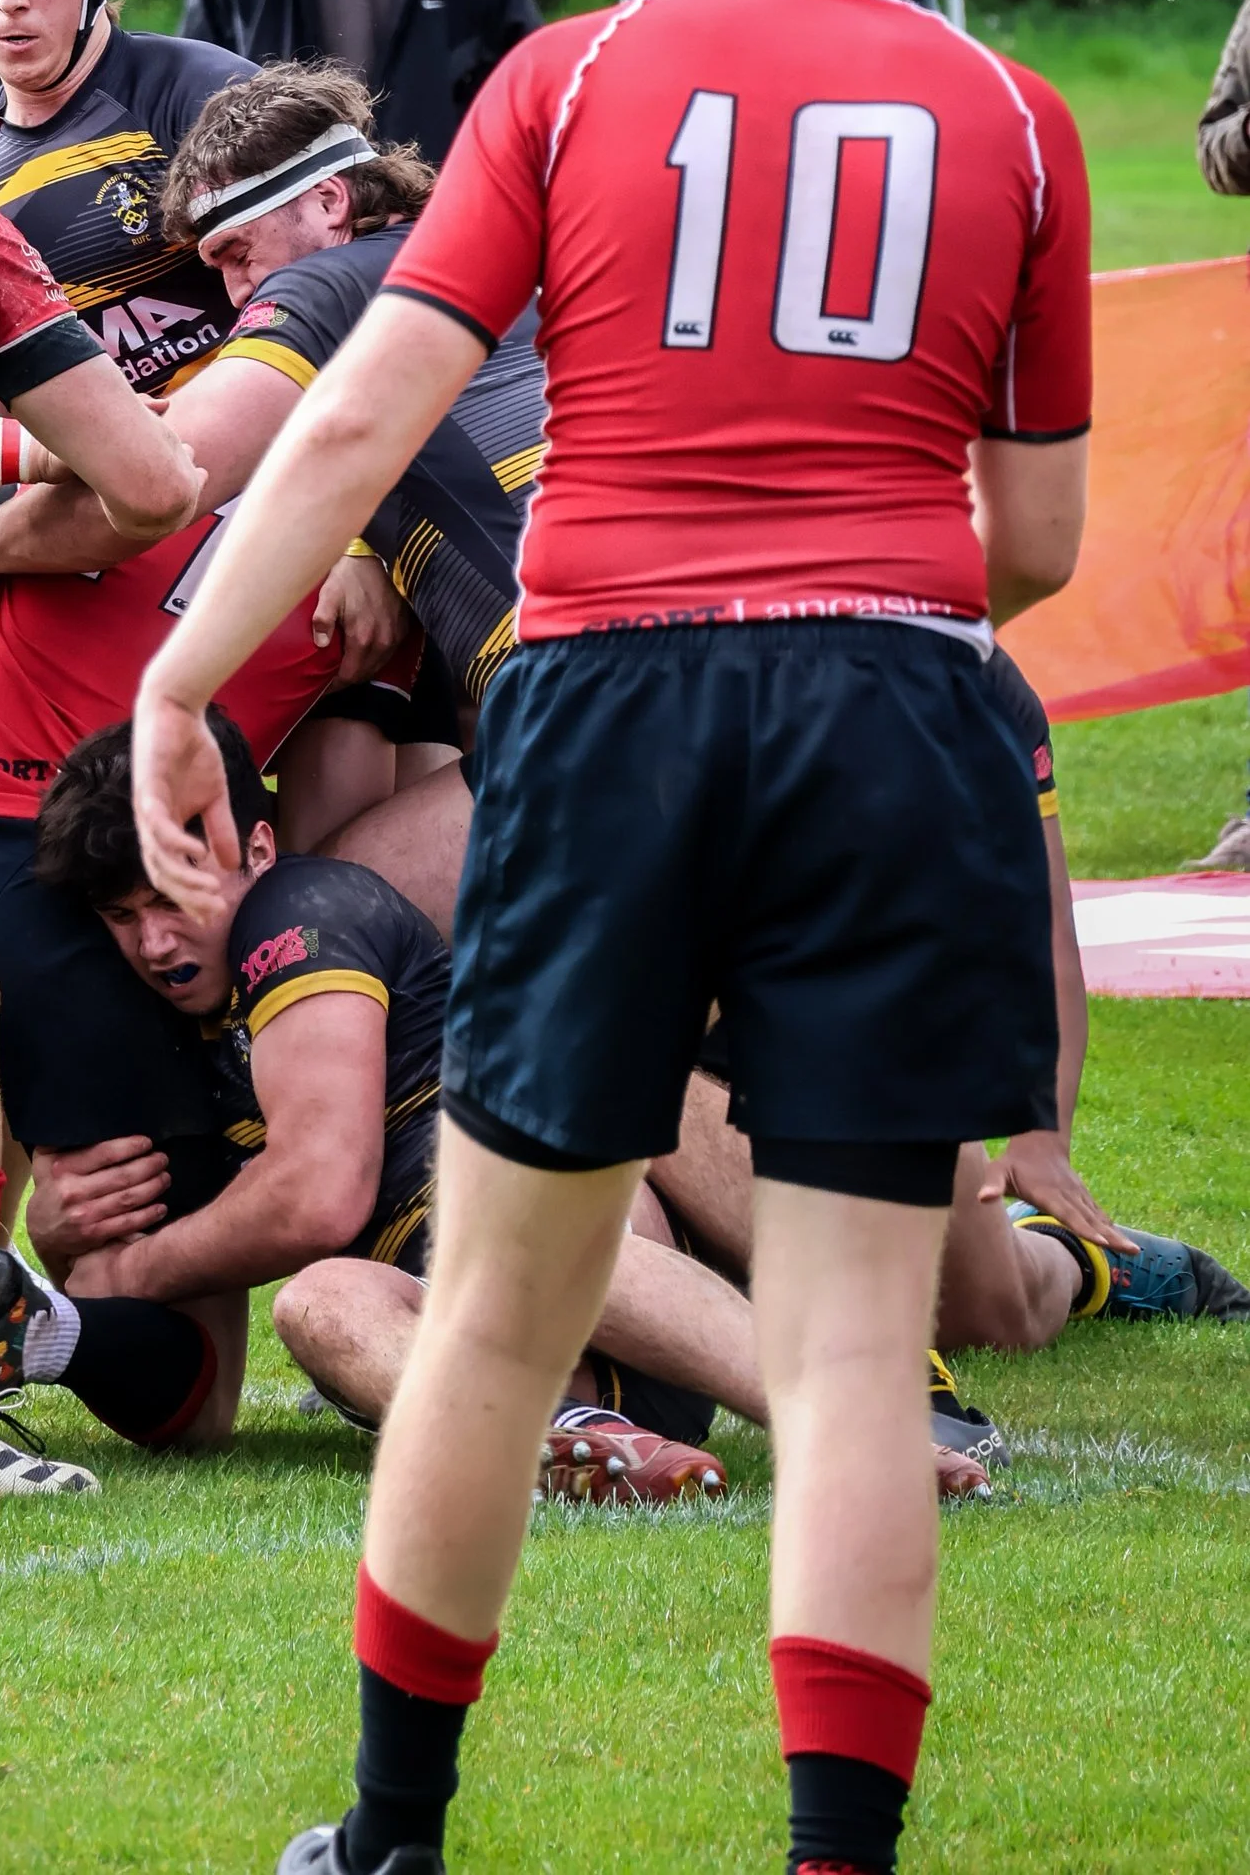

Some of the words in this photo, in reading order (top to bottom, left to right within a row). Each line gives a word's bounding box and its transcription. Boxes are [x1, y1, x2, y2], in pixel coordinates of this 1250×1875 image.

[95, 173, 123, 205] UNIVERSITY
[122, 172, 134, 180] OF
[131, 233, 152, 246] RUFC
[660, 88, 940, 364] 10
[79, 296, 206, 359] MA
[120, 323, 220, 384] dation
[240, 925, 305, 983] YORK
